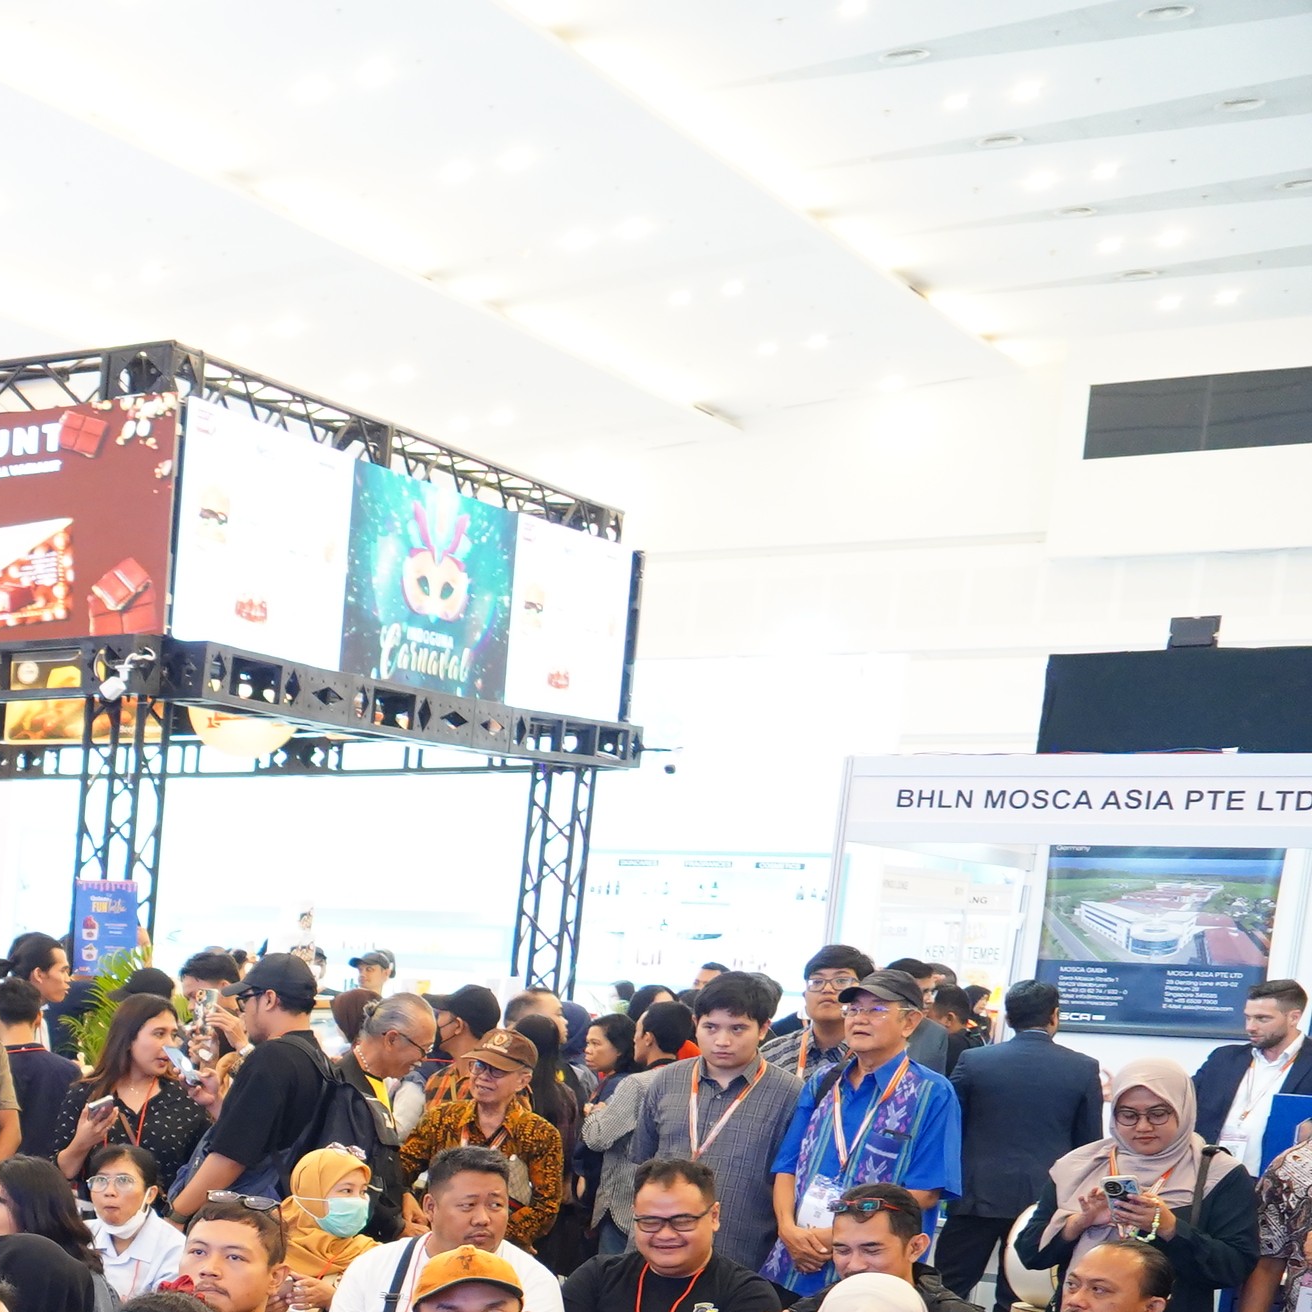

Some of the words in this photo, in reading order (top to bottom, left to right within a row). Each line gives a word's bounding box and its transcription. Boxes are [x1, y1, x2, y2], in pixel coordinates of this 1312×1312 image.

[896, 789, 973, 809] BHLN
[983, 789, 1093, 810] MOSCA
[1101, 789, 1174, 810] ASIA
[1184, 790, 1246, 811] PTE
[1257, 790, 1312, 811] LTD
[1059, 1012, 1091, 1021] SCA
